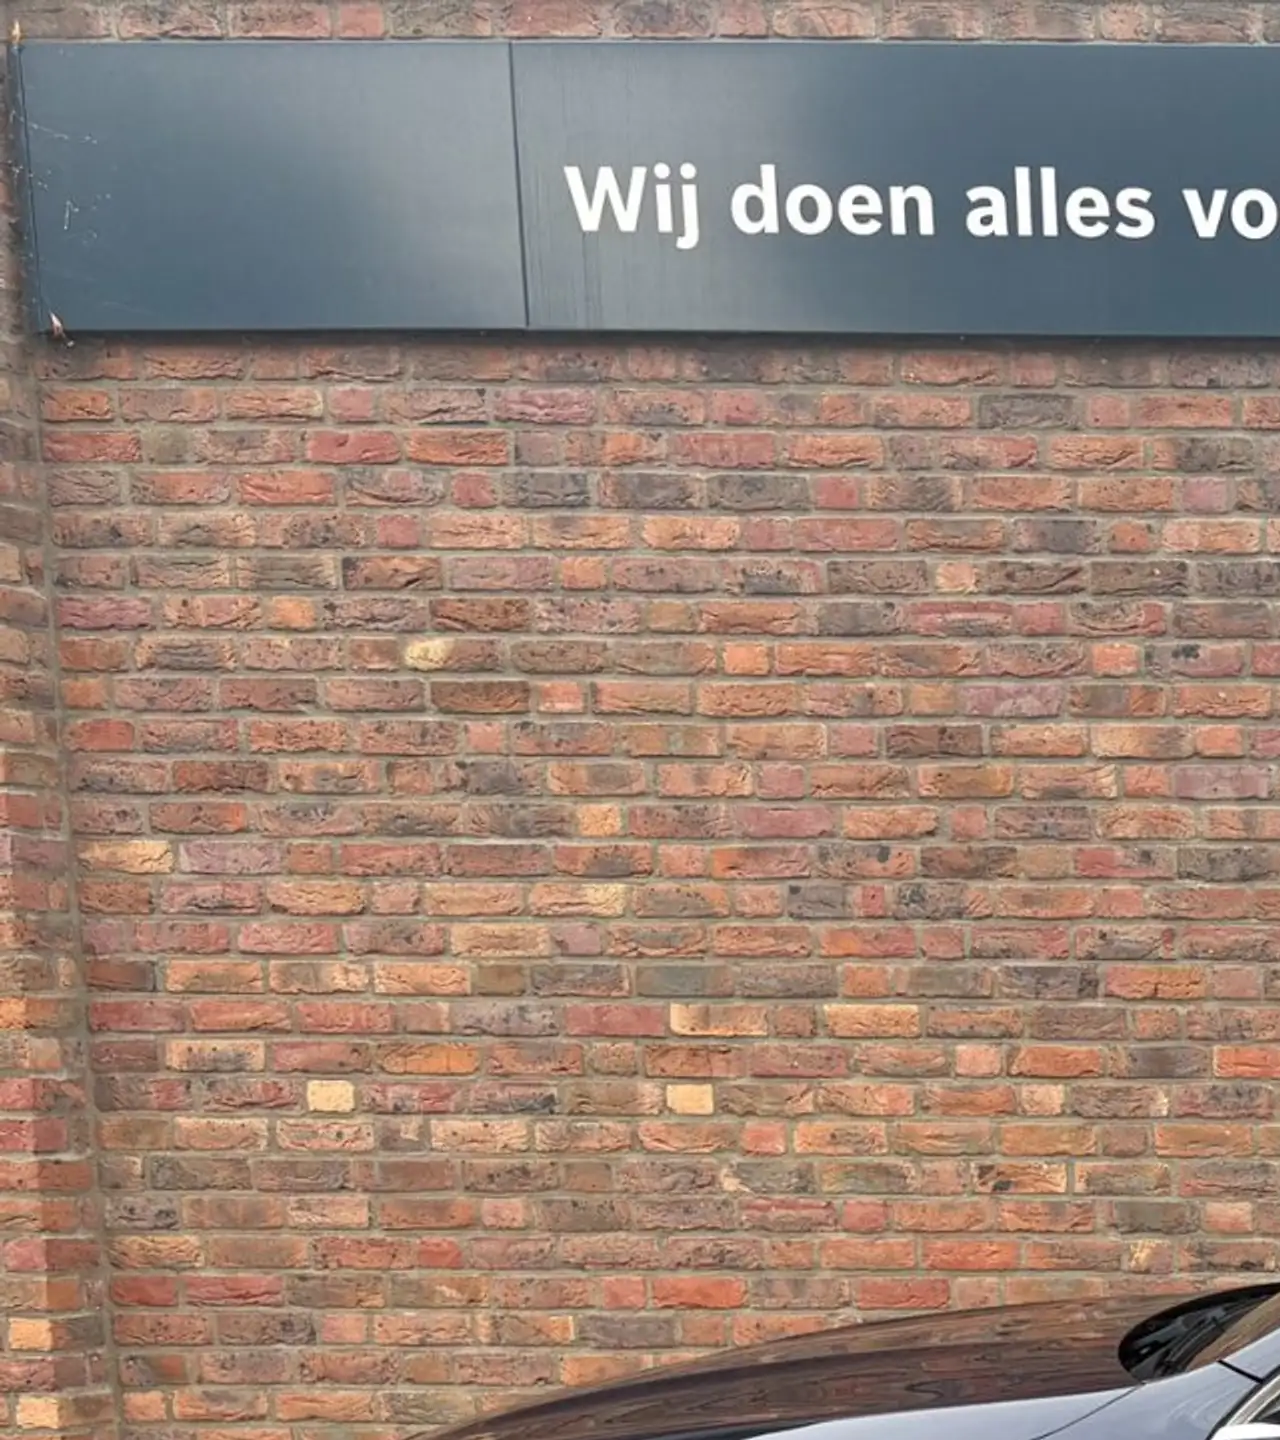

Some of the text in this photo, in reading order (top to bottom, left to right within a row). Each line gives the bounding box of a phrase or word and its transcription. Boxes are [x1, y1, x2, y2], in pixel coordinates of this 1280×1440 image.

[561, 160, 699, 251] Wij
[729, 162, 936, 237] doen
[965, 165, 1156, 240] alles
